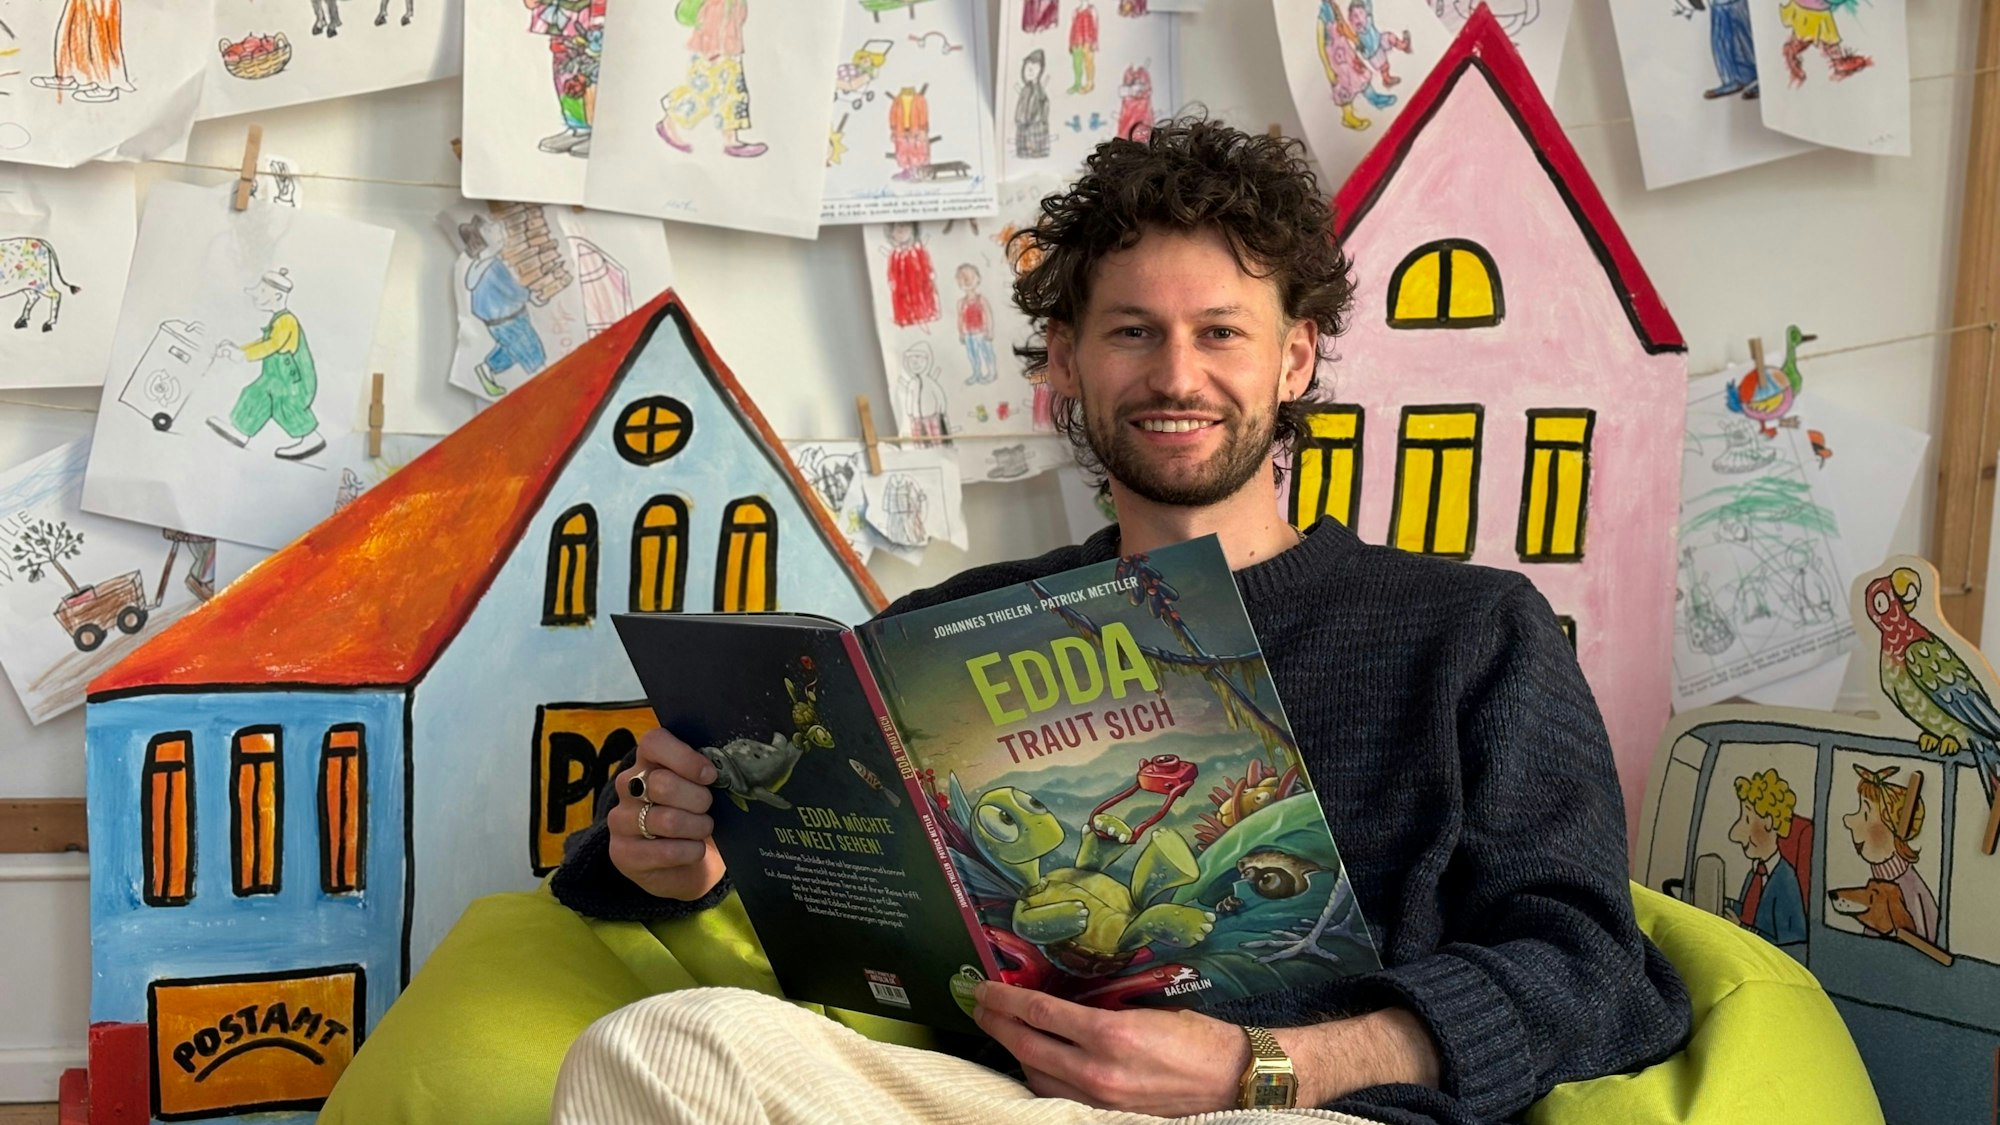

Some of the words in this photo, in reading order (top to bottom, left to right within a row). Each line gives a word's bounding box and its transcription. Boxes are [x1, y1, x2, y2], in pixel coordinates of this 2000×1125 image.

[933, 614, 986, 639] JOHANNES
[986, 603, 1034, 625] THIELEN
[1040, 588, 1087, 612] PATRICK
[1089, 576, 1140, 600] METTLER
[965, 622, 1159, 727] EDDA
[880, 715, 893, 732] SICH
[997, 711, 1099, 764] TRAUT
[1104, 698, 1175, 740] SICH
[886, 732, 902, 755] TRAUT
[895, 755, 914, 780] EDDA
[796, 806, 843, 830] EDDA
[842, 812, 895, 834] MÖCHTE
[922, 814, 938, 838] METTLER
[774, 827, 799, 845] DIE
[795, 829, 837, 851] WELT
[836, 834, 885, 856] SEHEN!
[933, 838, 948, 860] PATRICK
[943, 862, 957, 884] THIELEN
[952, 883, 968, 908] JOHANNES
[1164, 978, 1212, 997] BAESCHLIN
[173, 1002, 349, 1073] POSTAMT
